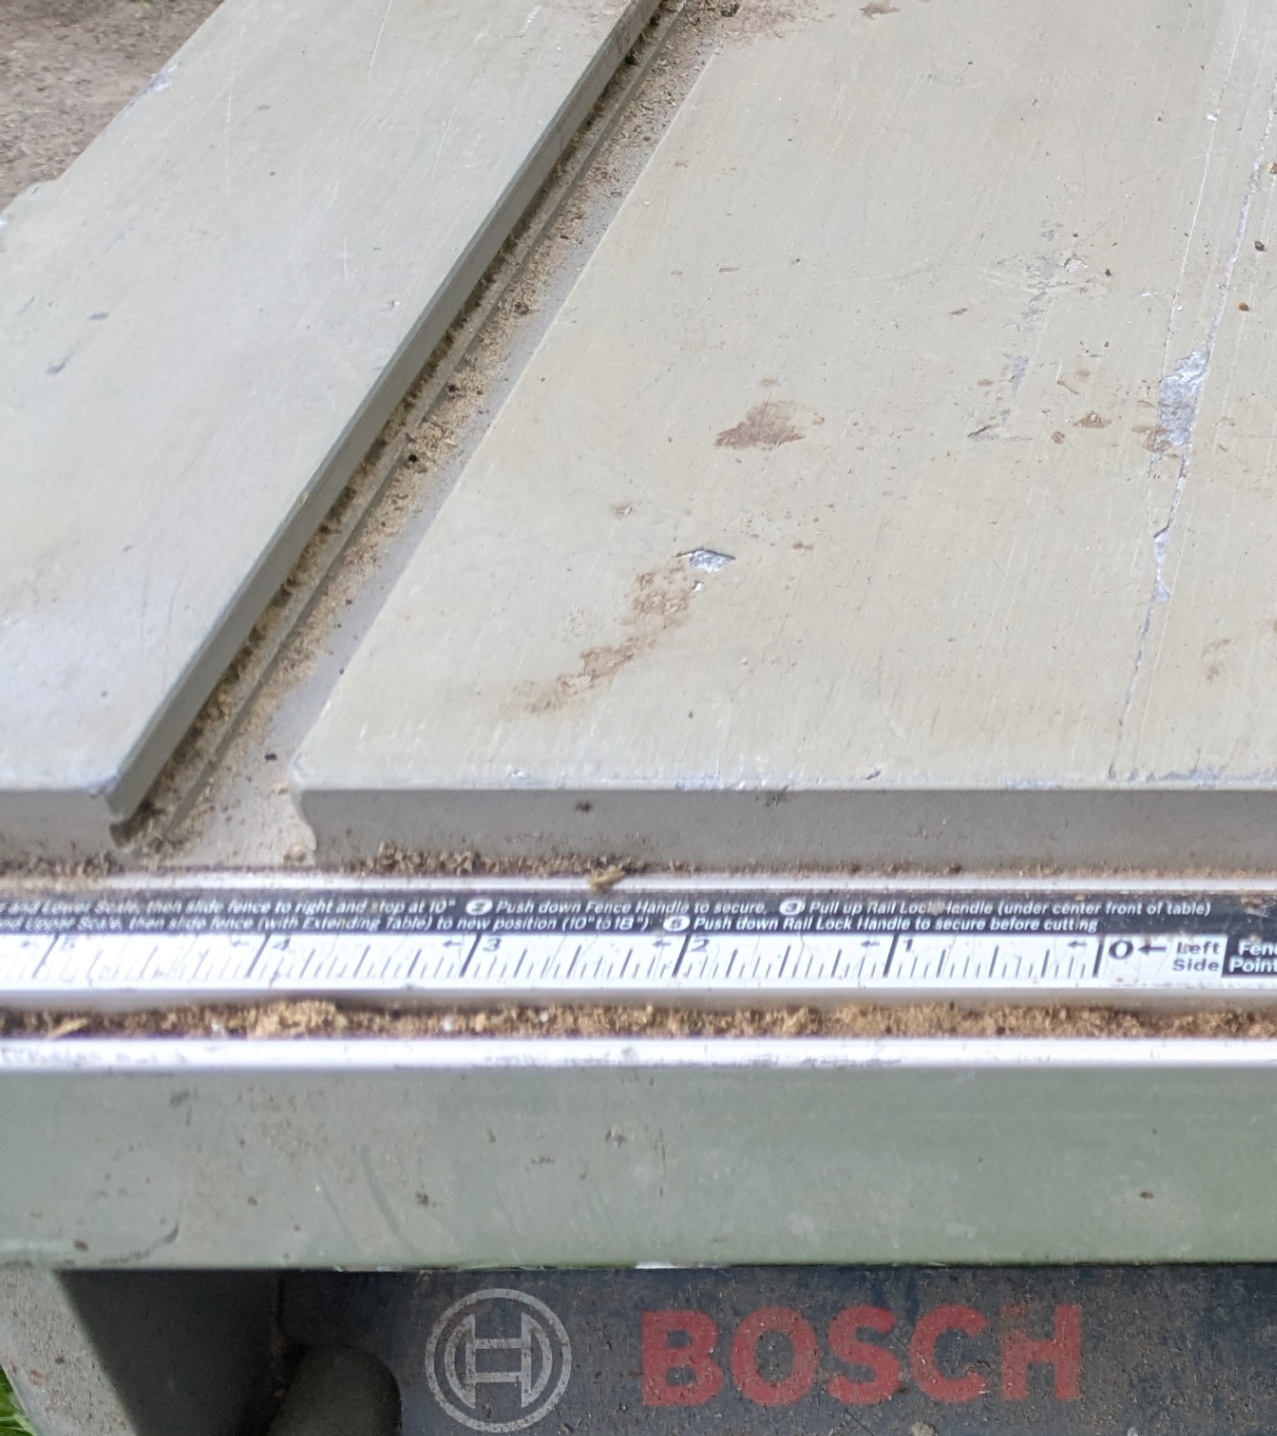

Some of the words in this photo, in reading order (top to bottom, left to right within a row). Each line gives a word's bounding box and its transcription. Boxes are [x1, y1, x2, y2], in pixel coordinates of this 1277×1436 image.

[274, 900, 292, 914] to
[295, 900, 332, 915] right
[336, 901, 364, 914] and
[408, 901, 424, 914] at
[496, 901, 534, 914] Push
[538, 901, 581, 914] down
[586, 901, 631, 914] Fence
[635, 900, 689, 914] Handle
[694, 901, 709, 914] to
[809, 901, 838, 914] Pull
[843, 902, 862, 916] up
[867, 901, 895, 914] Rail
[998, 900, 1049, 916] (under
[1053, 901, 1101, 915] center
[1105, 902, 1146, 915] front
[1150, 902, 1165, 915] of
[1167, 902, 1211, 916] table)
[257, 917, 298, 931] (with
[303, 917, 380, 932] Extending
[385, 917, 432, 931] Table)
[437, 918, 453, 930] to
[457, 918, 489, 930] new
[493, 918, 558, 931] position
[693, 918, 732, 930] Push
[736, 918, 779, 930] down
[783, 918, 812, 930] Rail
[816, 918, 852, 930] Lock
[857, 918, 910, 931] Handle
[915, 918, 930, 930] to
[934, 919, 985, 930] secure
[990, 918, 1039, 930] before
[1043, 918, 1102, 933] cutting
[273, 937, 291, 950] 4
[482, 938, 502, 951] 3
[691, 938, 710, 952] 2
[903, 938, 914, 952] 1
[1177, 941, 1221, 955] Left
[1172, 958, 1220, 972] Side
[641, 1304, 1083, 1407] BOSCH
